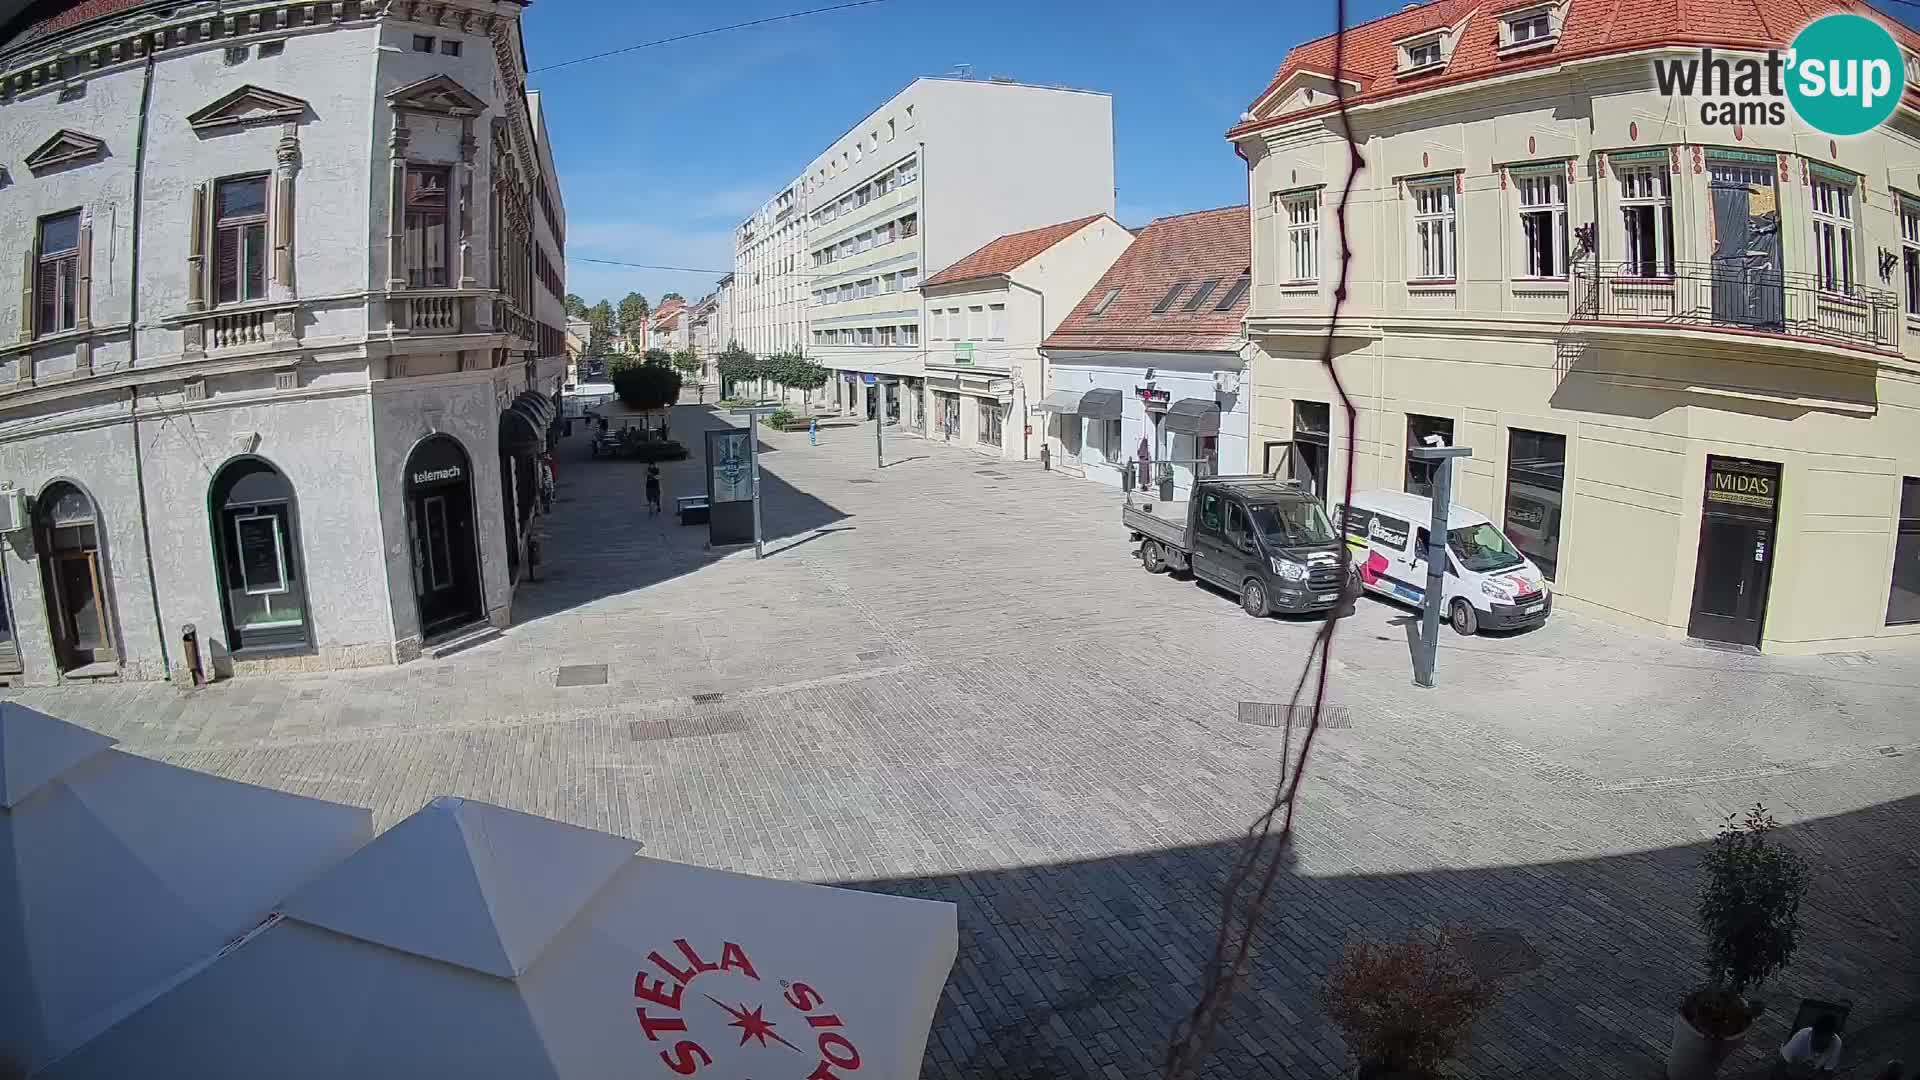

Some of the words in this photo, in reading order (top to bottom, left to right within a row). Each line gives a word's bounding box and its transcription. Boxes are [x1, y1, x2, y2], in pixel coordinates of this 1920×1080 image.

[414, 465, 461, 484] telemach
[1715, 473, 1769, 494] MIDAS
[634, 938, 761, 1075] STELLA
